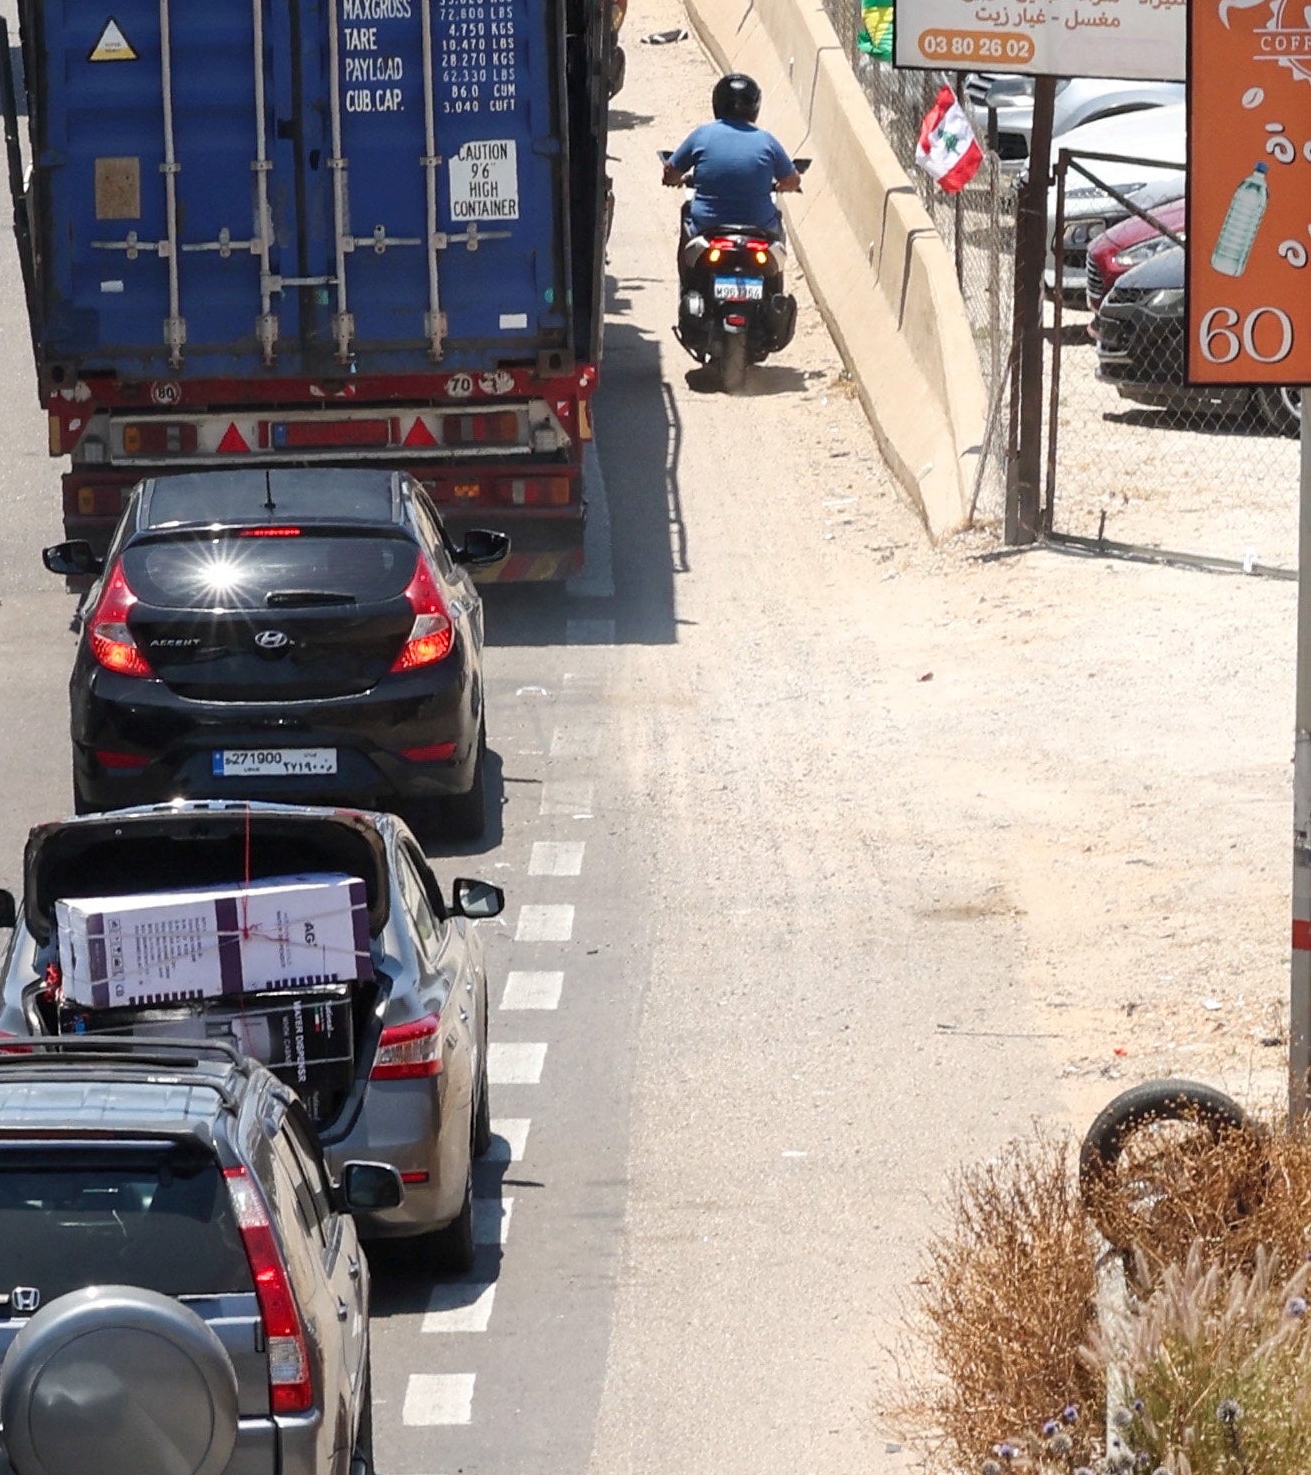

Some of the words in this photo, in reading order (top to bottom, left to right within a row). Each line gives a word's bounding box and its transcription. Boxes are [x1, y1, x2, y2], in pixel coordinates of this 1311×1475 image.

[490, 6, 513, 19] LBS
[975, 6, 1010, 26] زيت
[1016, 8, 1047, 27] غيار
[1065, 10, 1121, 30] مغسل
[344, 28, 378, 51] TARE
[491, 22, 514, 36] KGS
[492, 37, 514, 50] LBS
[924, 36, 947, 53] 03
[952, 37, 974, 54] 80
[979, 38, 1001, 56] 26
[1006, 39, 1029, 57] 02
[345, 57, 403, 82] PAYLOAD
[493, 52, 515, 66] KGS
[493, 68, 516, 81] LBS
[346, 89, 405, 112] CUB.CAP.
[494, 84, 516, 97] CUM
[490, 99, 516, 112] CUFT
[458, 143, 508, 162] CAUTION
[469, 181, 499, 198] HIGH
[453, 199, 517, 217] CONTAINER
[1199, 306, 1294, 365] 60
[232, 751, 283, 766] 271900
